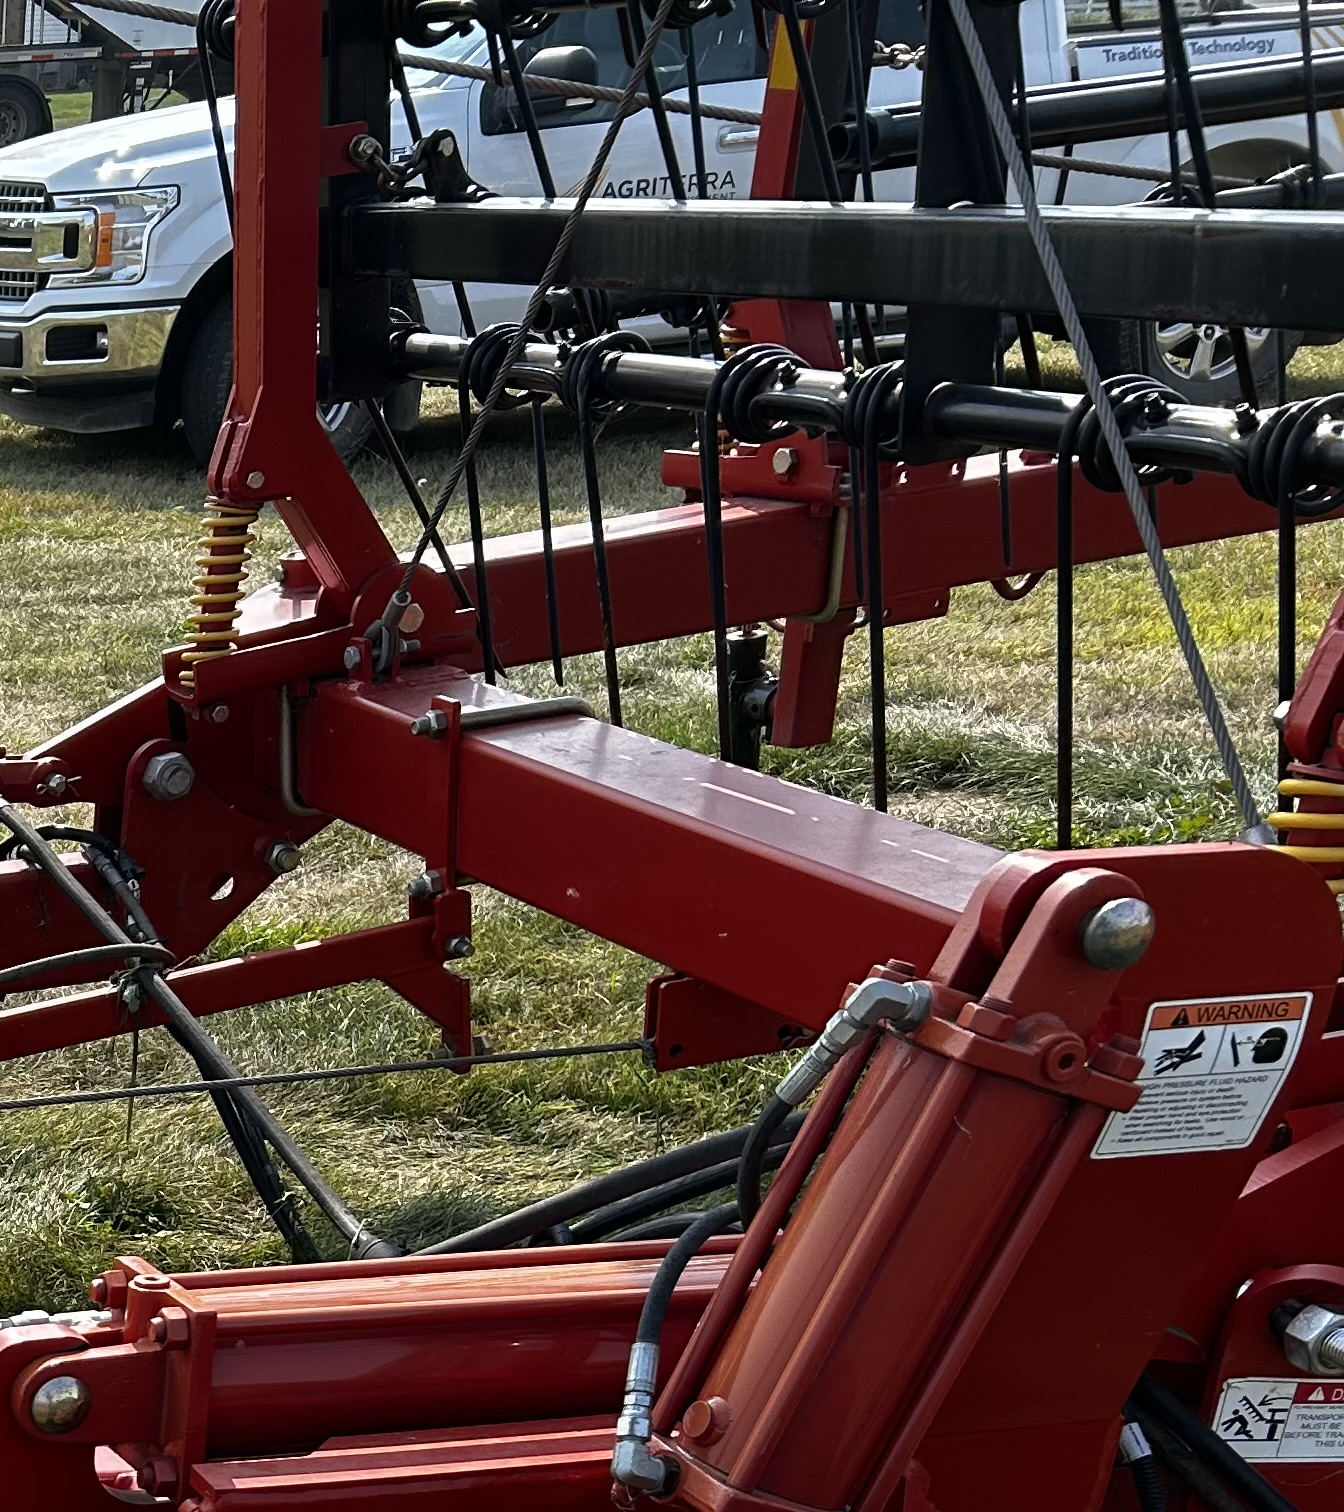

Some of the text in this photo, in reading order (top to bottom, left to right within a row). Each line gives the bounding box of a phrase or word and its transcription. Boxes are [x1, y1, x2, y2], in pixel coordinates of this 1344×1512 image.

[1189, 37, 1275, 56] Technology
[1197, 1002, 1289, 1023] WARNING
[1163, 1080, 1208, 1088] PRESSURE
[1234, 1075, 1269, 1083] HAZARD
